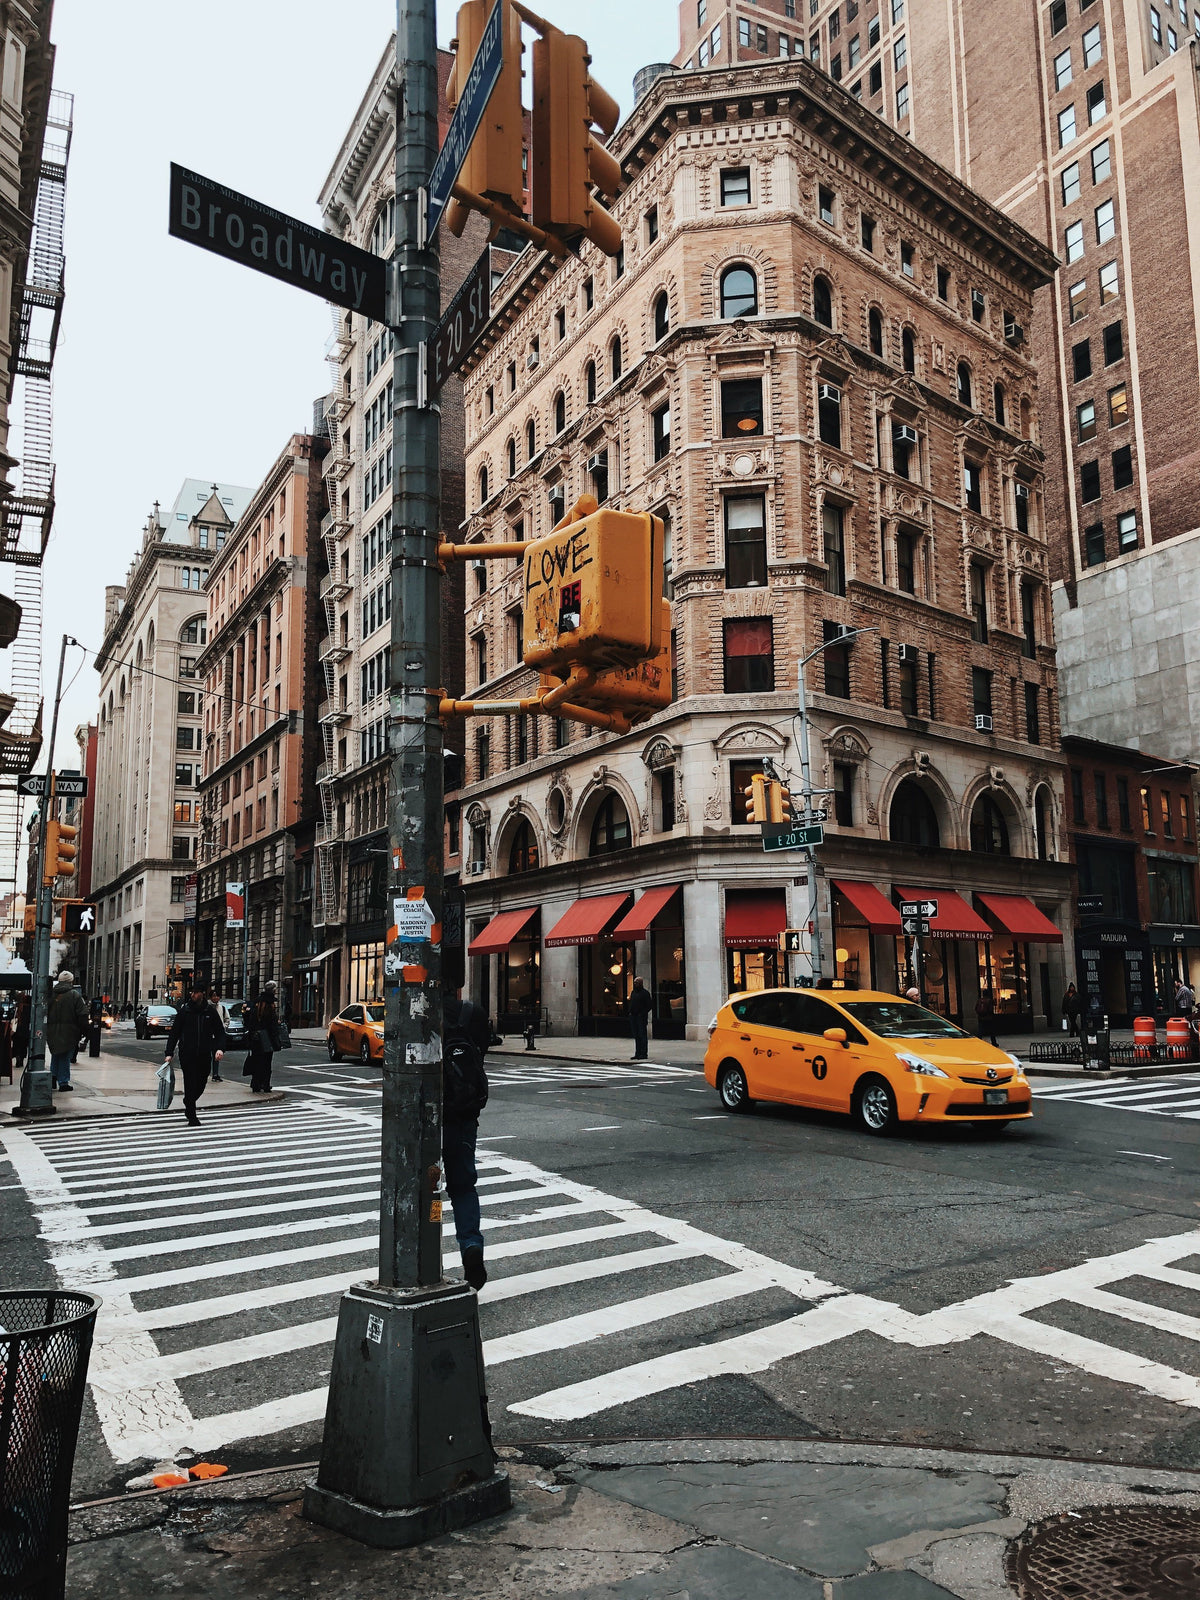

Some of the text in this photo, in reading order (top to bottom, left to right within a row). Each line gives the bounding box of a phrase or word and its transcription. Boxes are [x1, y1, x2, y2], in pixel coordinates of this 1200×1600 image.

[460, 9, 499, 129] ROOSEVELT
[182, 169, 322, 239] LADIES' MILE HISTORIC DISTRICT
[180, 183, 367, 309] Broadway
[436, 276, 483, 383] E 20 St
[526, 527, 593, 592] LOVE
[29, 781, 79, 791] ON WAY
[778, 831, 808, 845] E 20 St
[903, 905, 929, 914] ONE AY
[976, 932, 994, 940] REACH
[1100, 933, 1128, 942] MADURA
[815, 1060, 824, 1077] T
